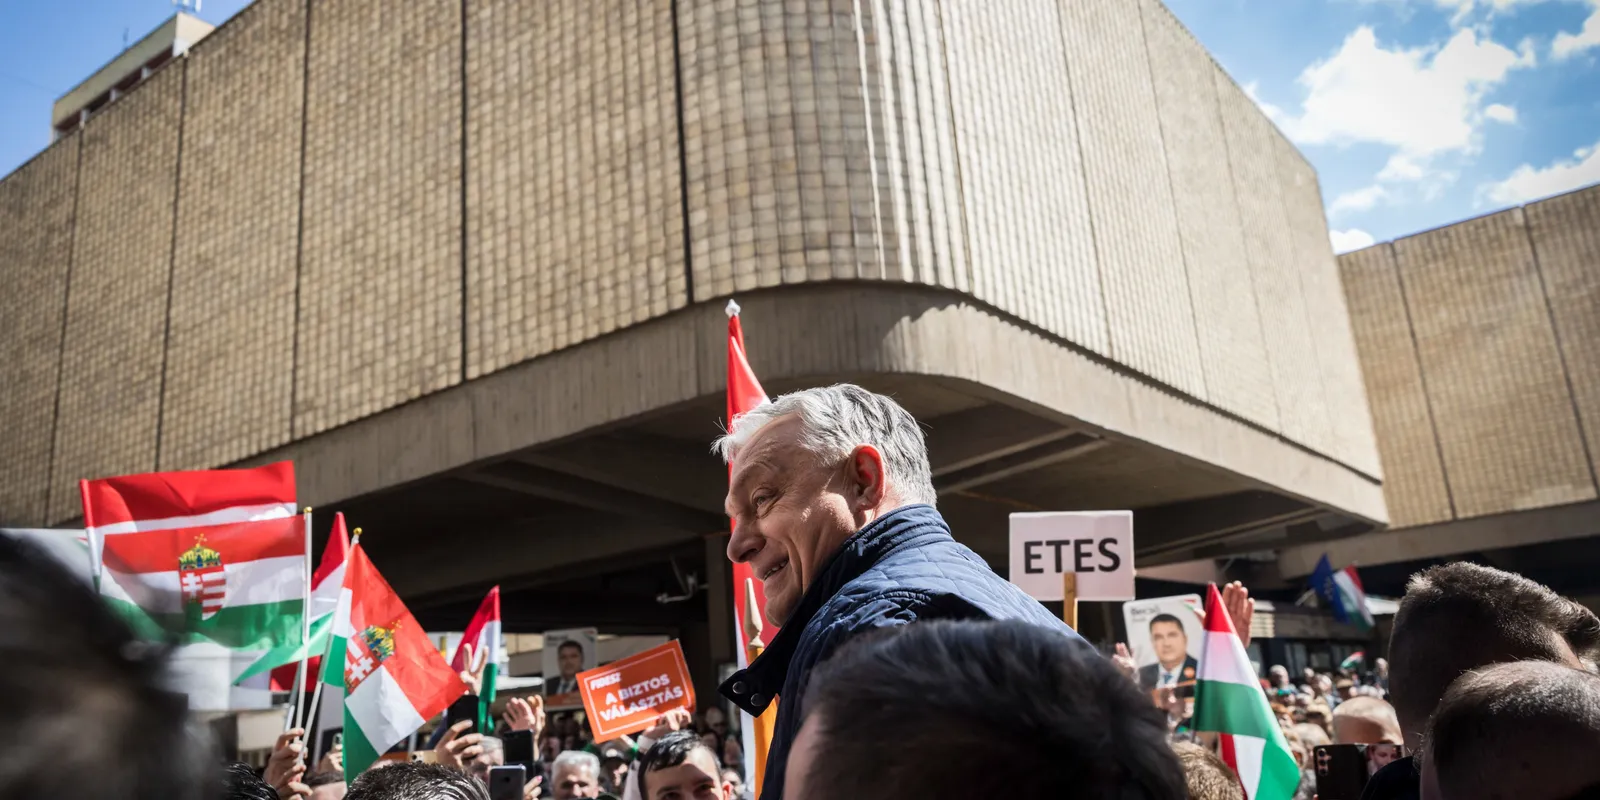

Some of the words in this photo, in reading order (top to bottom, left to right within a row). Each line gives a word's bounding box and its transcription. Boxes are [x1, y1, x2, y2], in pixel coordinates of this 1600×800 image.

[1024, 538, 1121, 574] ETES
[600, 686, 684, 721] VÁLASZTÁS
[605, 692, 618, 706] A
[618, 674, 670, 700] BIZTOS
